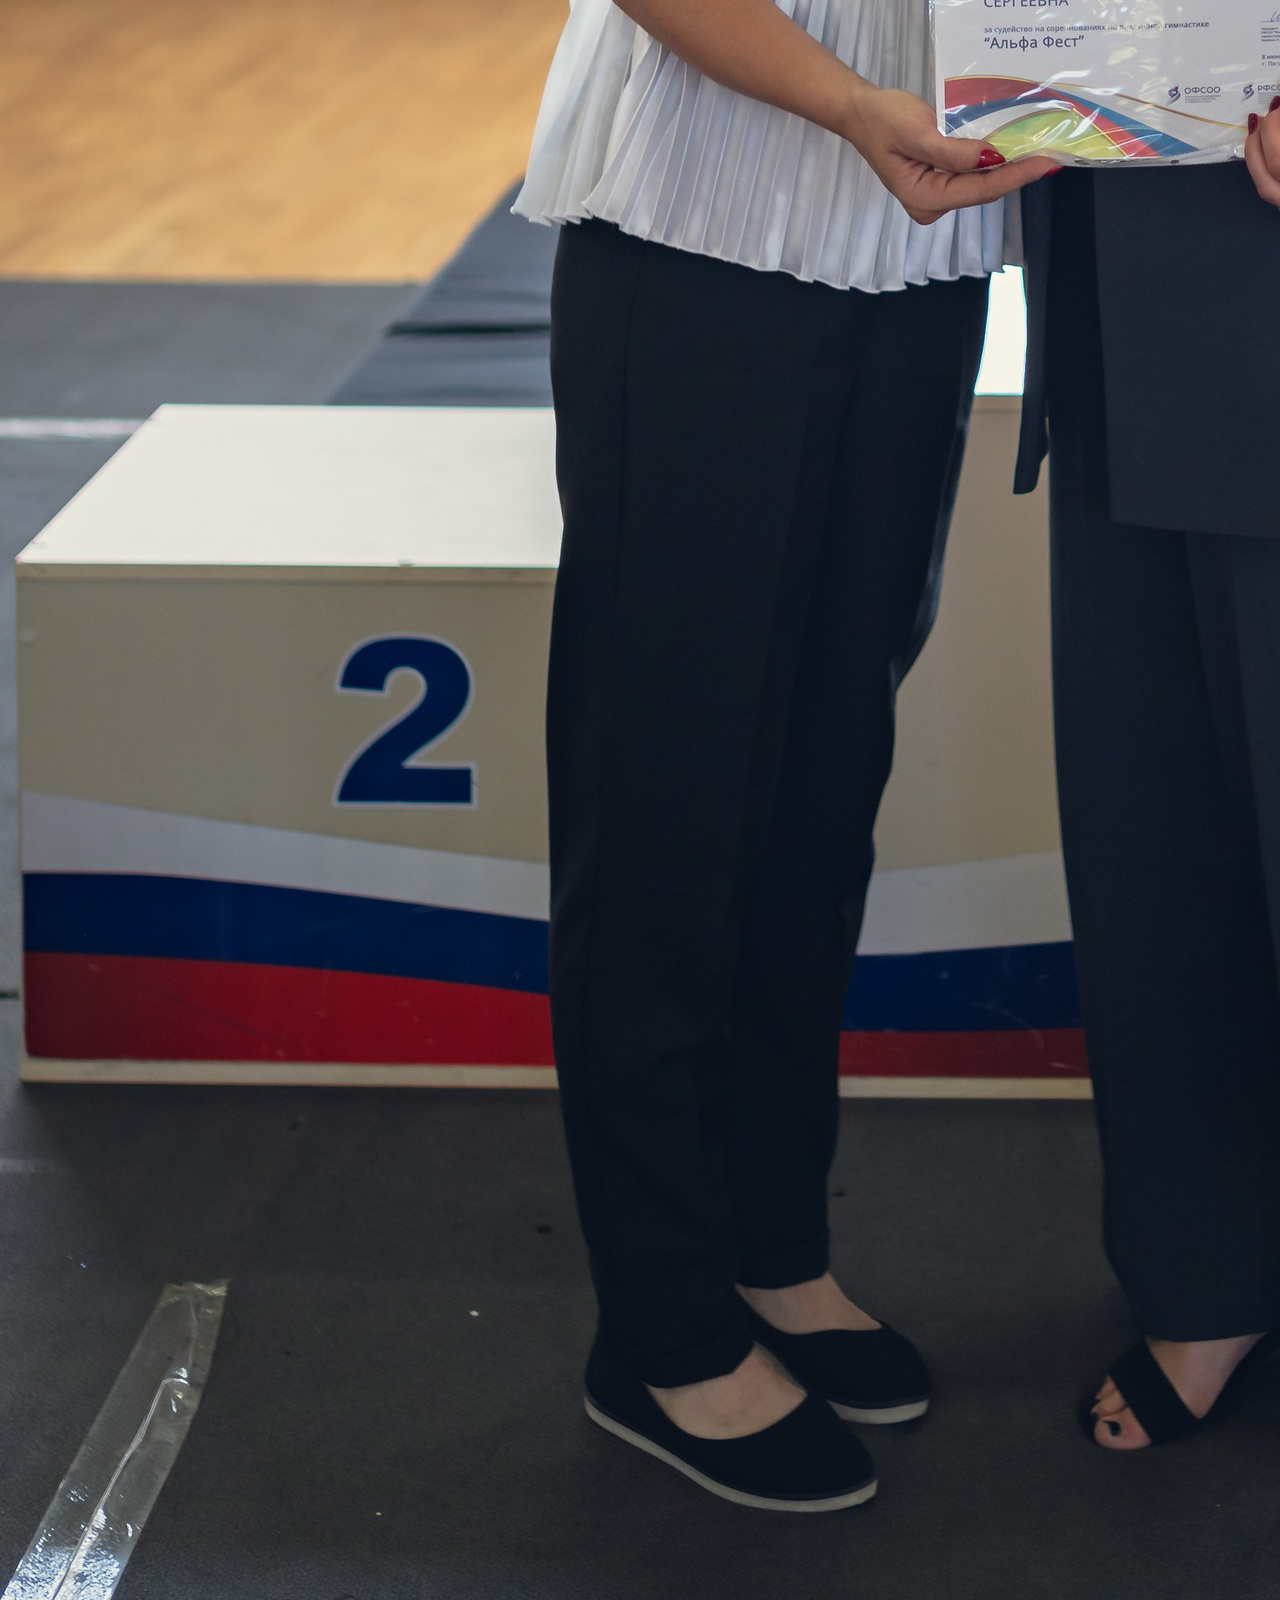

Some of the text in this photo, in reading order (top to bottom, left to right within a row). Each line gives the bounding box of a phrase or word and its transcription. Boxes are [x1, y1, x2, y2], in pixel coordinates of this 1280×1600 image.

[994, 25, 1032, 35] судейство
[1046, 24, 1106, 34] соренованиях
[1164, 21, 1209, 30] гимнастике
[1184, 86, 1221, 95] ОФСОО
[335, 635, 474, 804] 2
